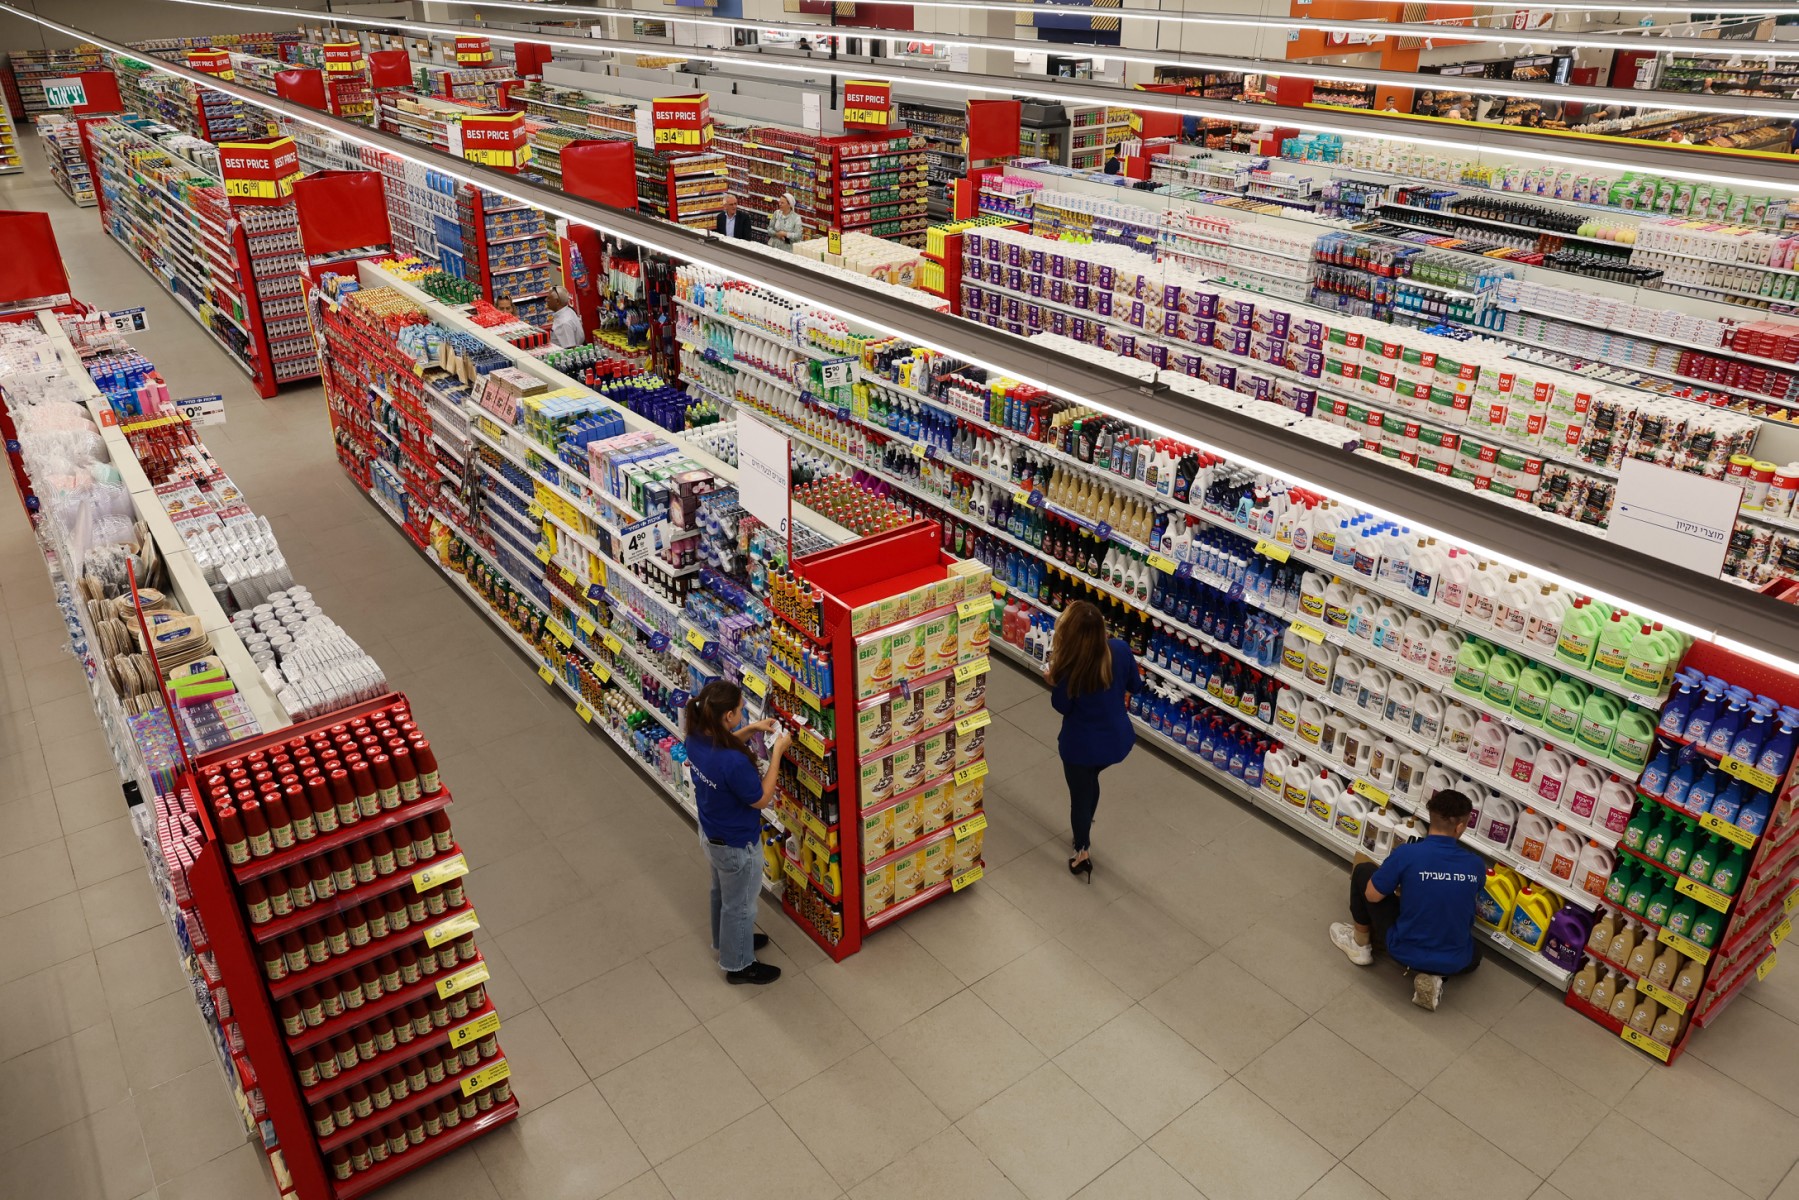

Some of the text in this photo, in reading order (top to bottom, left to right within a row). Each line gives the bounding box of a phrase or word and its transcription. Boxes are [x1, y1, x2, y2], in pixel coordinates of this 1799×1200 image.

[53, 86, 85, 104] יציאה
[846, 94, 885, 104] BEST PRICE
[656, 111, 697, 120] BEST PRICE
[467, 130, 510, 140] BEST PRICE
[225, 158, 270, 169] BEST PRICE
[274, 152, 296, 169] BEST PRICE
[780, 518, 787, 532] 6
[1676, 521, 1724, 540] מוצרי ניקיון
[963, 604, 970, 612] 9
[926, 623, 944, 636] BIO
[893, 635, 912, 648] BIO
[859, 647, 878, 660] BIO
[959, 667, 968, 676] 13
[1210, 677, 1220, 685] AJAX
[924, 687, 940, 698] BIO
[893, 701, 908, 711] BIO
[860, 712, 875, 723] BIO
[960, 720, 970, 728] 13
[926, 740, 940, 750] BIO
[895, 753, 910, 763] BIO
[1731, 762, 1738, 770] 6
[862, 766, 878, 778] BIO
[959, 771, 968, 779] 13
[1358, 782, 1365, 790] 15
[924, 788, 940, 799] BIO
[895, 801, 910, 814] BIO
[866, 817, 880, 830] BIO
[1711, 818, 1718, 827] 6
[958, 825, 967, 834] 13
[926, 846, 940, 857] BIO
[896, 860, 911, 871] BIO
[422, 873, 430, 883] 8
[866, 873, 881, 886] BIO
[956, 877, 964, 885] 13
[1419, 870, 1478, 883] אני פה בשבילך
[1685, 883, 1693, 892] 4
[1667, 934, 1675, 943] 4
[445, 980, 454, 989] 8
[1646, 984, 1653, 992] 6
[458, 1030, 466, 1039] 8
[1630, 1031, 1637, 1040] 6
[470, 1077, 478, 1087] 8
